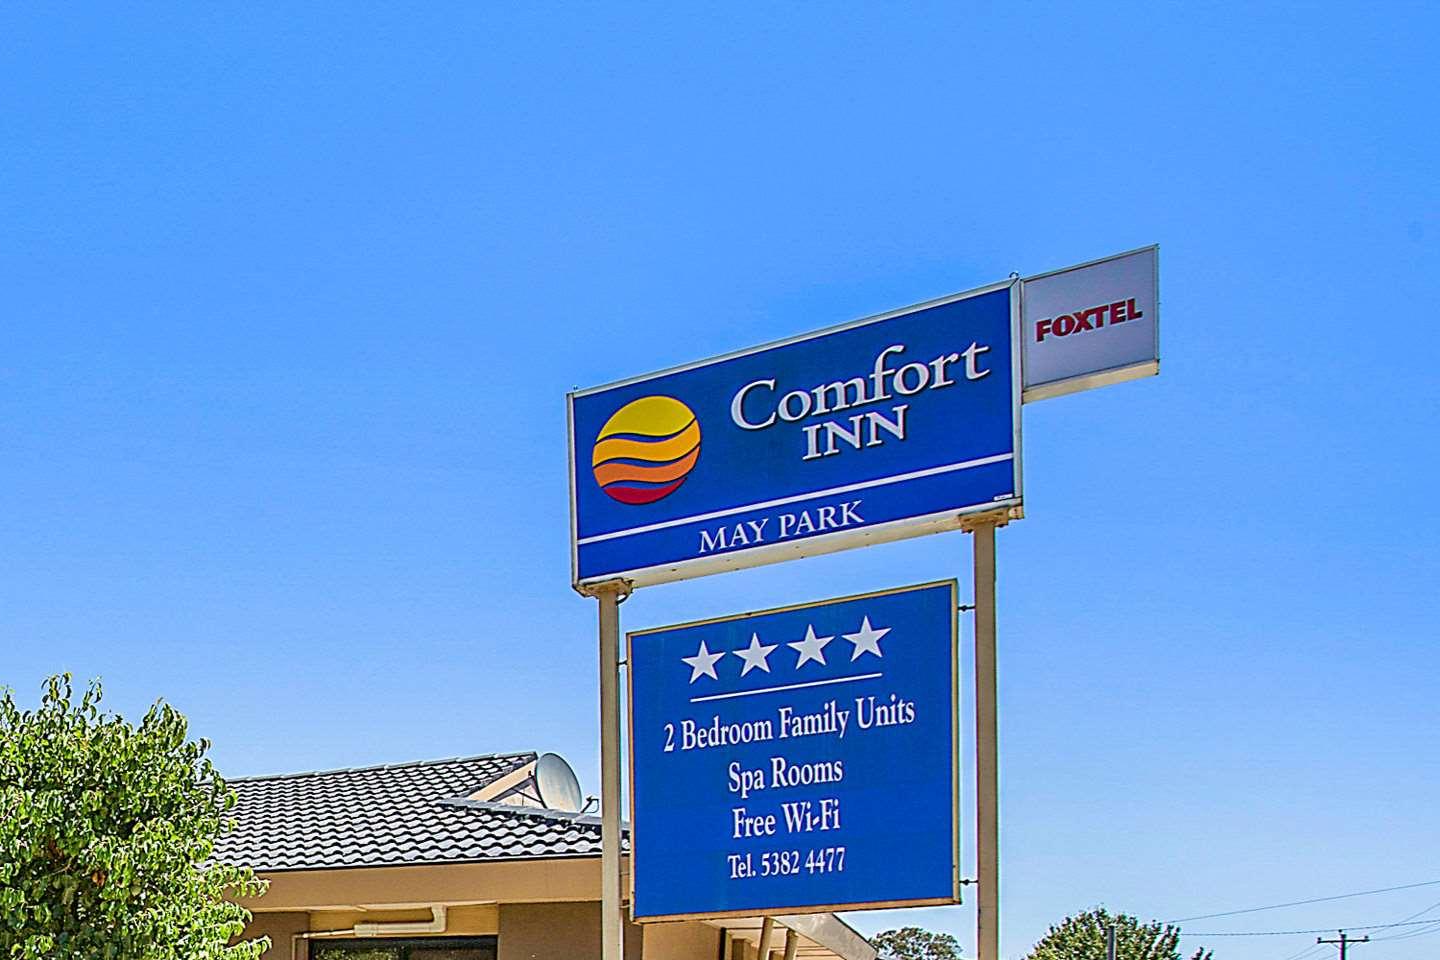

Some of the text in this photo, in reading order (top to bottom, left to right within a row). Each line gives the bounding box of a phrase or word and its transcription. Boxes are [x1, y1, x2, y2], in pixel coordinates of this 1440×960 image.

[1035, 298, 1143, 343] FOXTEL
[730, 341, 991, 431] Comfort
[802, 404, 909, 461] INN
[698, 500, 865, 554] MAY PARK
[663, 694, 915, 752] 2 Bedroom Family Units
[728, 757, 843, 798] Spa Rooms
[732, 799, 841, 839] Free Wi-Fi
[728, 847, 846, 879] Tel. 5382 4477
